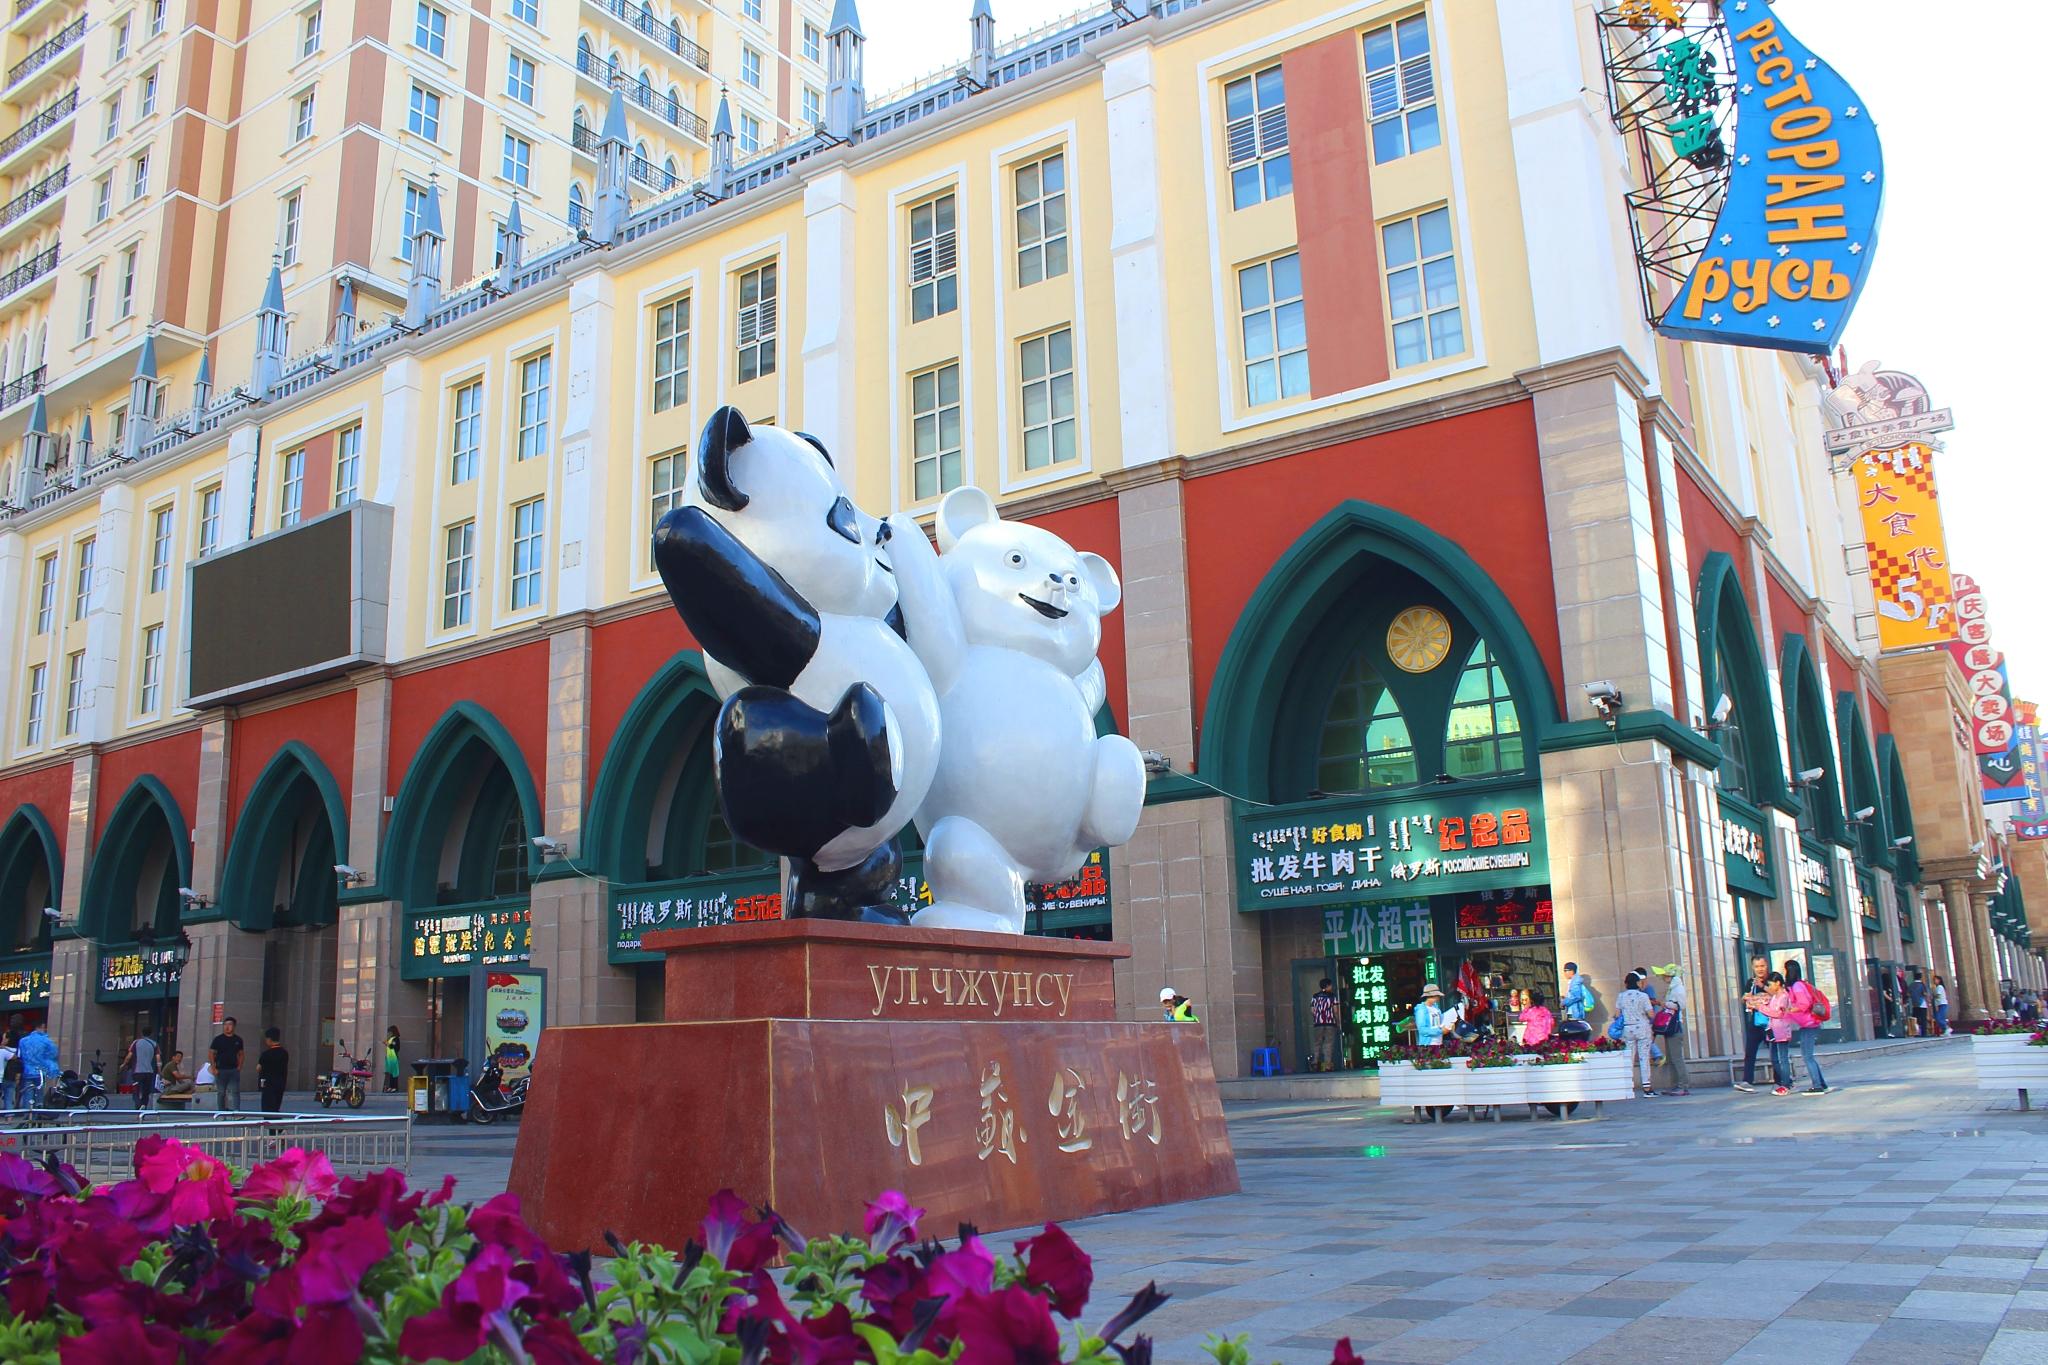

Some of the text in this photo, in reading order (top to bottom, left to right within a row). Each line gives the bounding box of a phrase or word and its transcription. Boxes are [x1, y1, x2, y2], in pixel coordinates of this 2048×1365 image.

[1736, 17, 1848, 244] РЕСТОРАН
[1863, 483, 1944, 571] 大食代
[1311, 822, 1364, 845] 好食购
[1437, 807, 1531, 851] 纪念品
[1250, 845, 1383, 884] 批发牛肉干
[1390, 855, 1441, 882] 俄罗斯
[639, 898, 693, 925] 俄罗斯
[734, 893, 782, 921] 古玩店
[1322, 901, 1431, 956] 平价超市
[104, 975, 144, 991] СУМКИ
